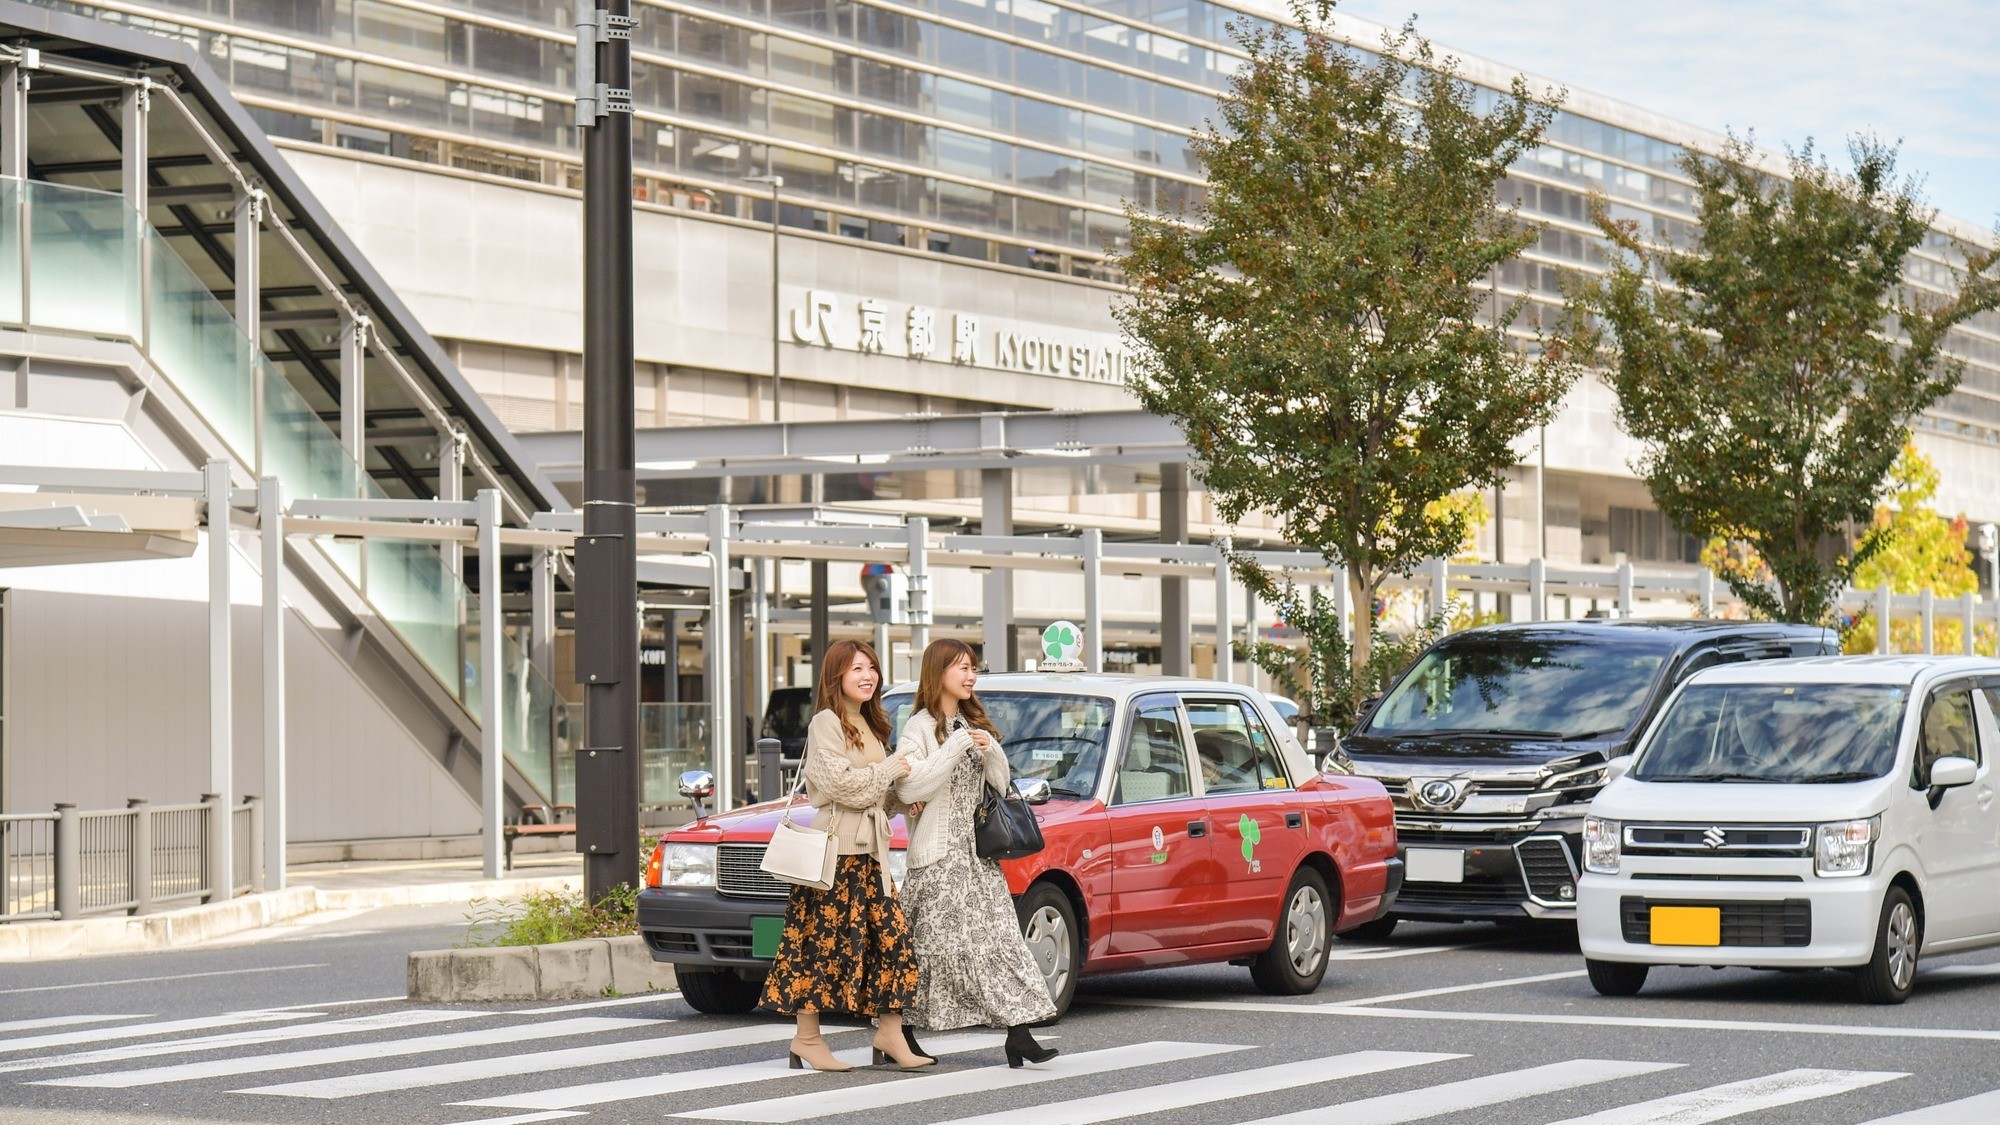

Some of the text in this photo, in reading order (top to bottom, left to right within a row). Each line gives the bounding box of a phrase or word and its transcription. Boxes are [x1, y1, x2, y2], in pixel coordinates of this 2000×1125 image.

[792, 290, 838, 347] JR
[858, 299, 980, 363] 京都駅
[996, 331, 1064, 372] KYOTO
